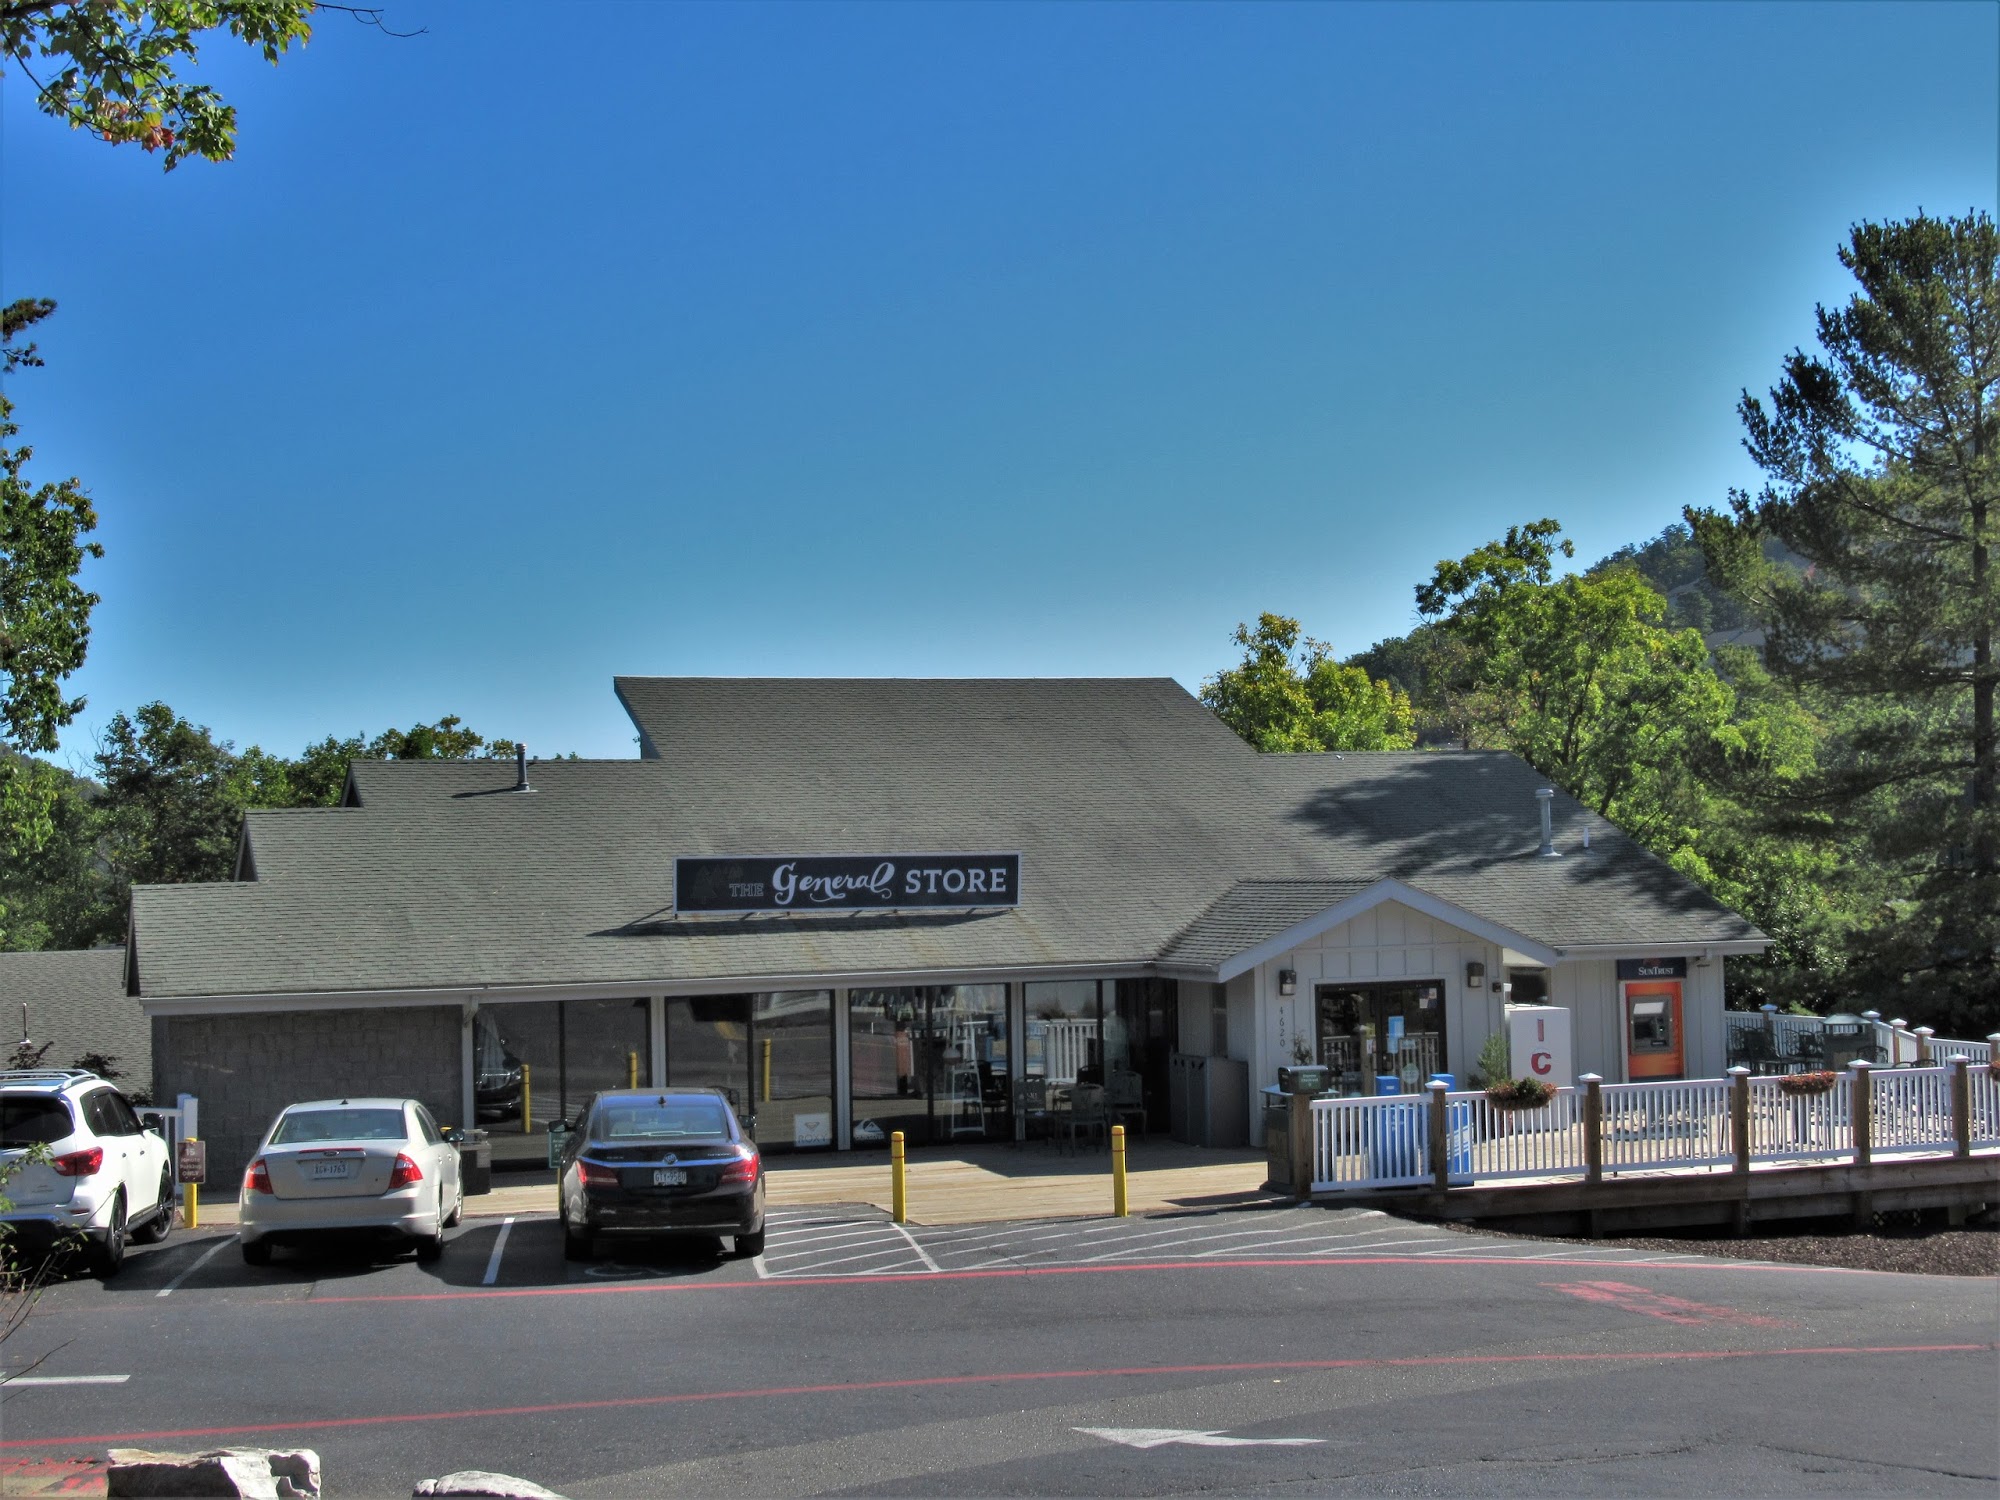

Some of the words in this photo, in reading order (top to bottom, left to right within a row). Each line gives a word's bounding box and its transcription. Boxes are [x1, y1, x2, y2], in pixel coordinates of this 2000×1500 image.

[729, 882, 764, 897] THE
[772, 861, 896, 905] General
[905, 868, 1007, 894] STORE
[1530, 1018, 1552, 1076] IC
[185, 1148, 196, 1156] 15
[798, 1133, 827, 1144] ROXY
